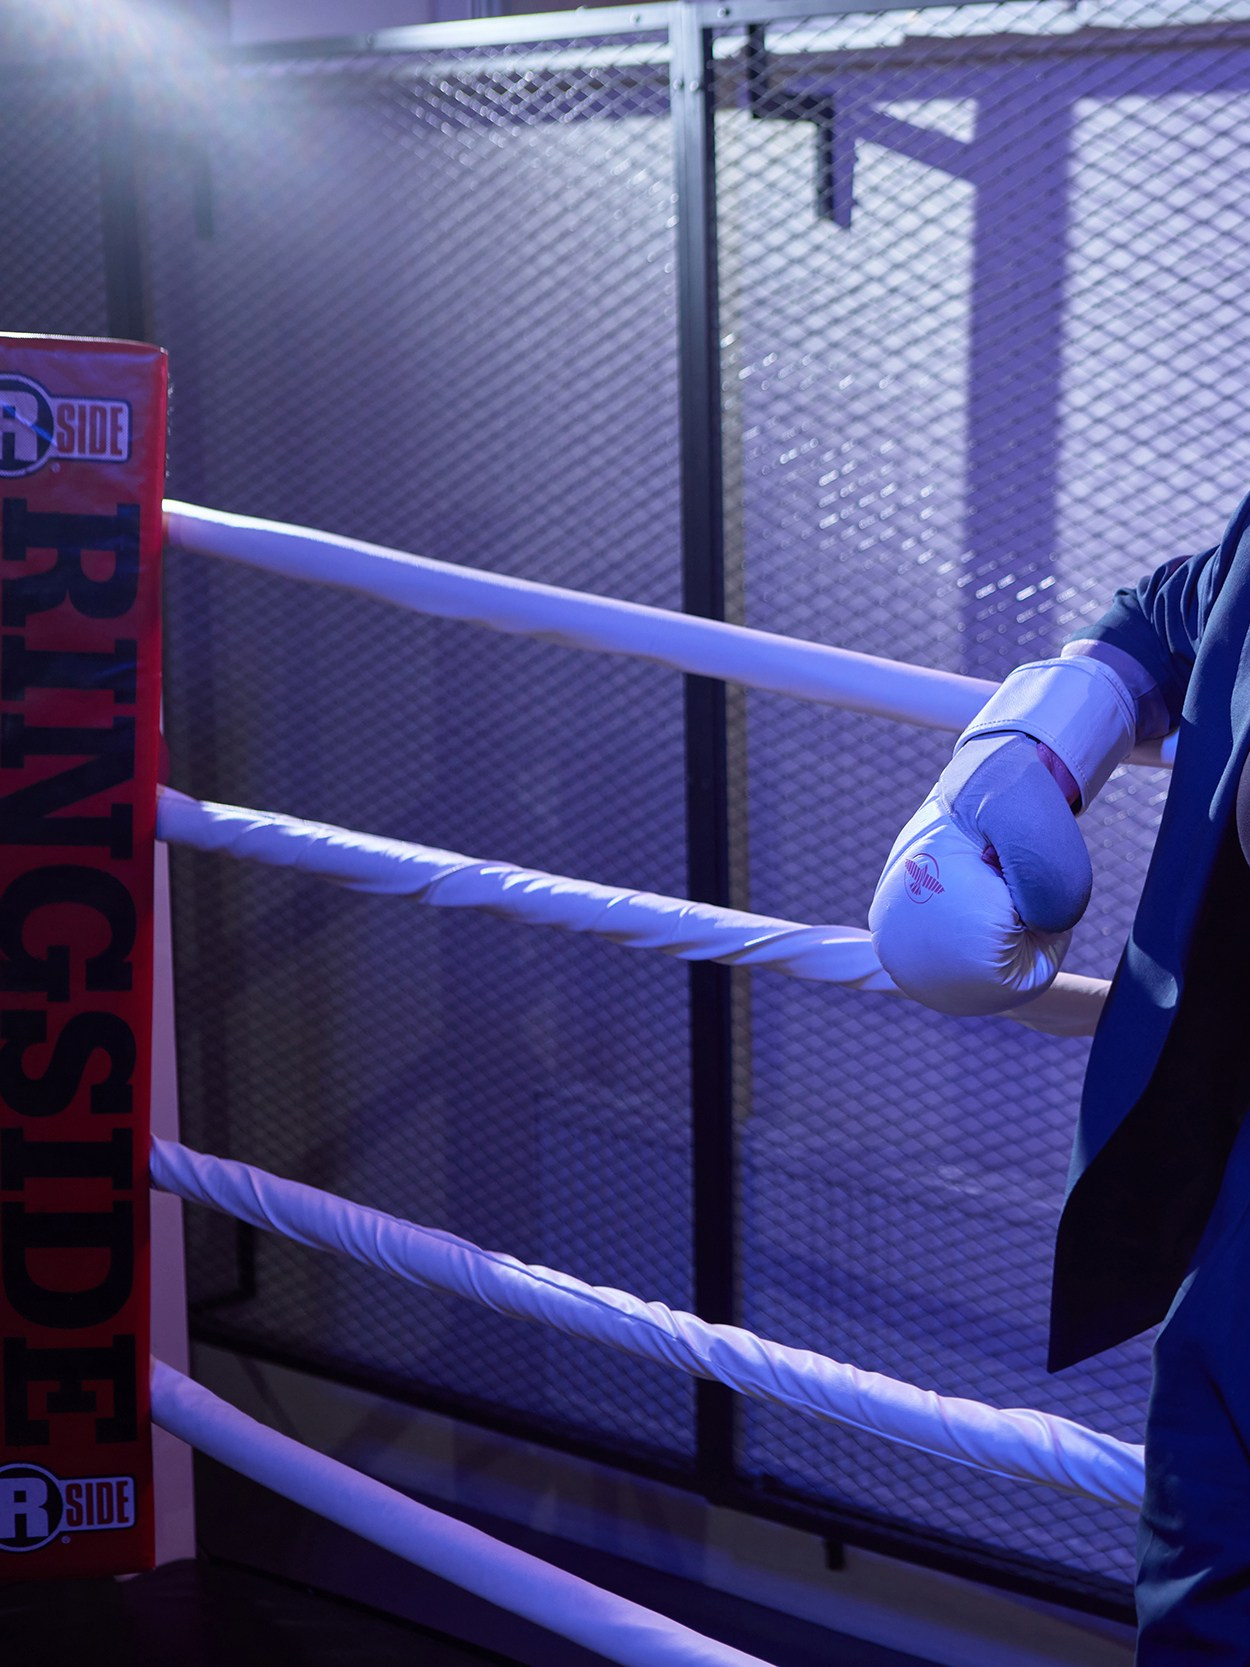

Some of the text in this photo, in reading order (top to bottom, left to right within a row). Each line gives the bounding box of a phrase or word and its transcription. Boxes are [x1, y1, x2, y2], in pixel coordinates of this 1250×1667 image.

[56, 402, 124, 456] SIDE
[0, 498, 141, 1445] RINGSIDE
[0, 1477, 130, 1539] R SIDE
